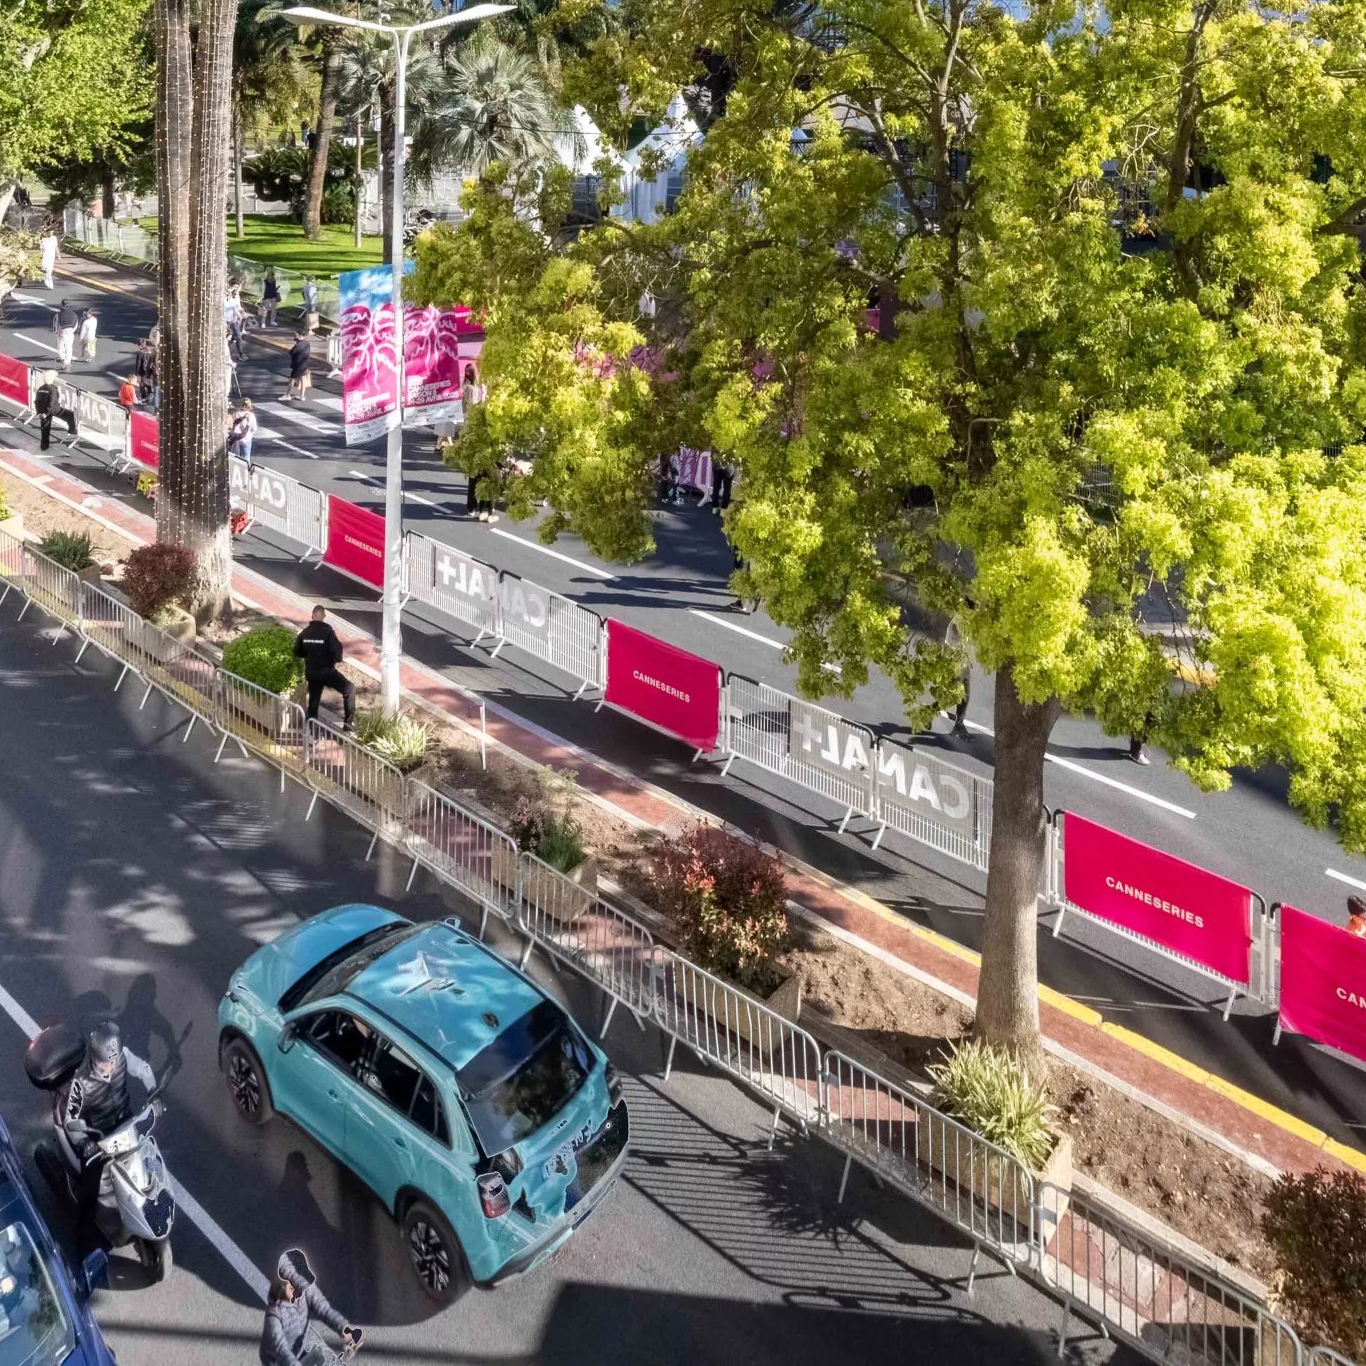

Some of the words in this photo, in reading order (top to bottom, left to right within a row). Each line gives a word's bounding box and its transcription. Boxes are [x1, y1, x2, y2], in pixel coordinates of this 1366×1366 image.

[344, 534, 382, 558] CANNESERIES
[633, 670, 691, 703] CANNESERIES
[1105, 876, 1204, 928] CANNESERIES
